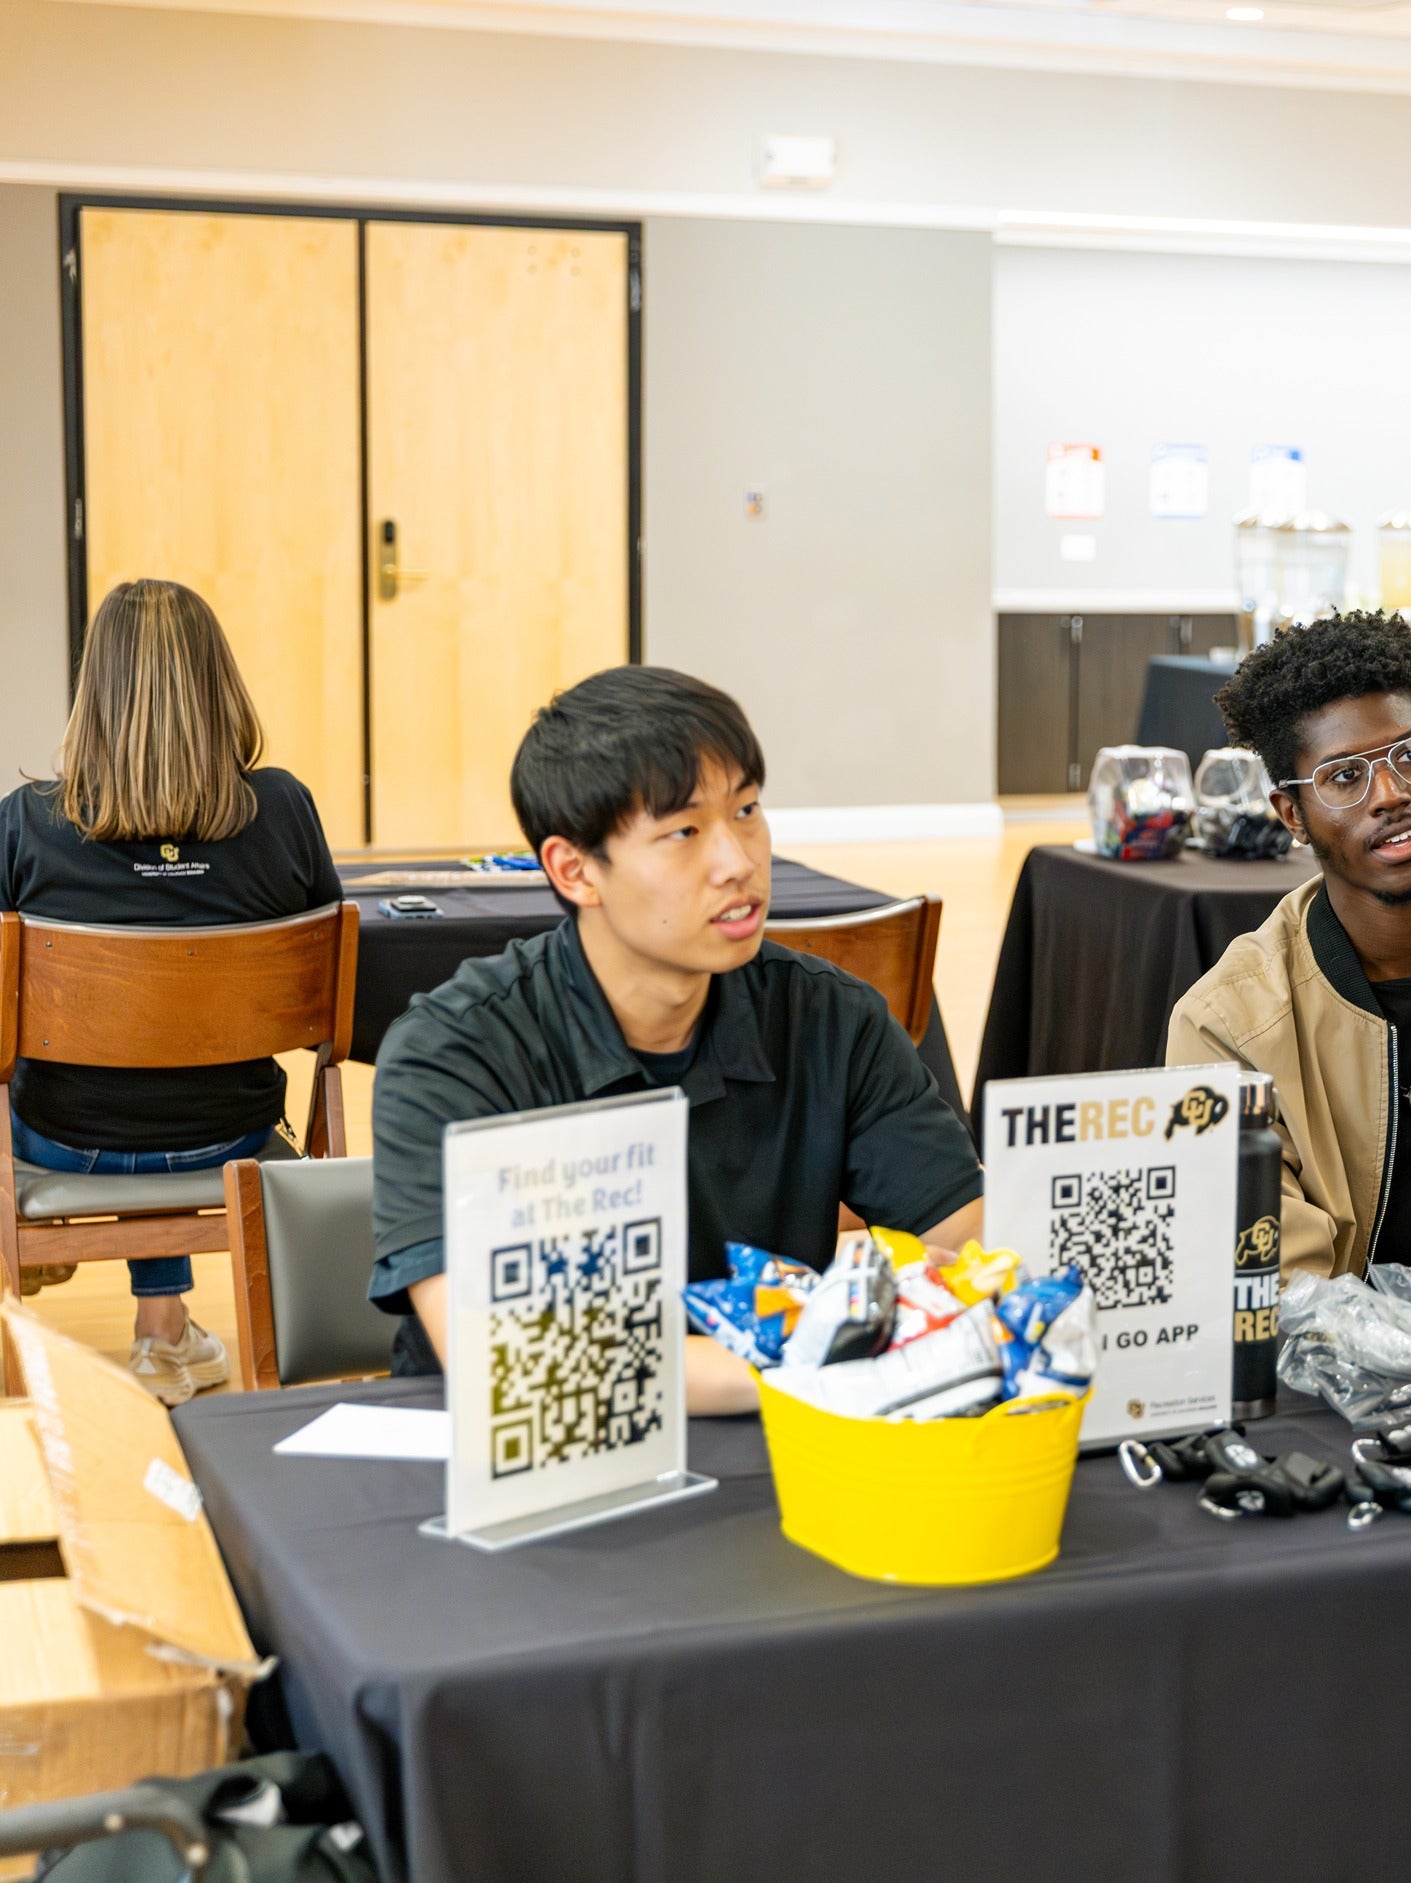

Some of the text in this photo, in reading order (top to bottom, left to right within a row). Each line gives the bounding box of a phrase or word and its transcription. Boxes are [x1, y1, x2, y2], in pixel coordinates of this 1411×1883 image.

[498, 1142, 655, 1193] Find your fit
[511, 1177, 642, 1228] at The Rec!
[1234, 1272, 1280, 1310] THE
[1116, 1330, 1149, 1350] GO
[1155, 1324, 1200, 1346] APP
[1234, 1305, 1280, 1342] REC
